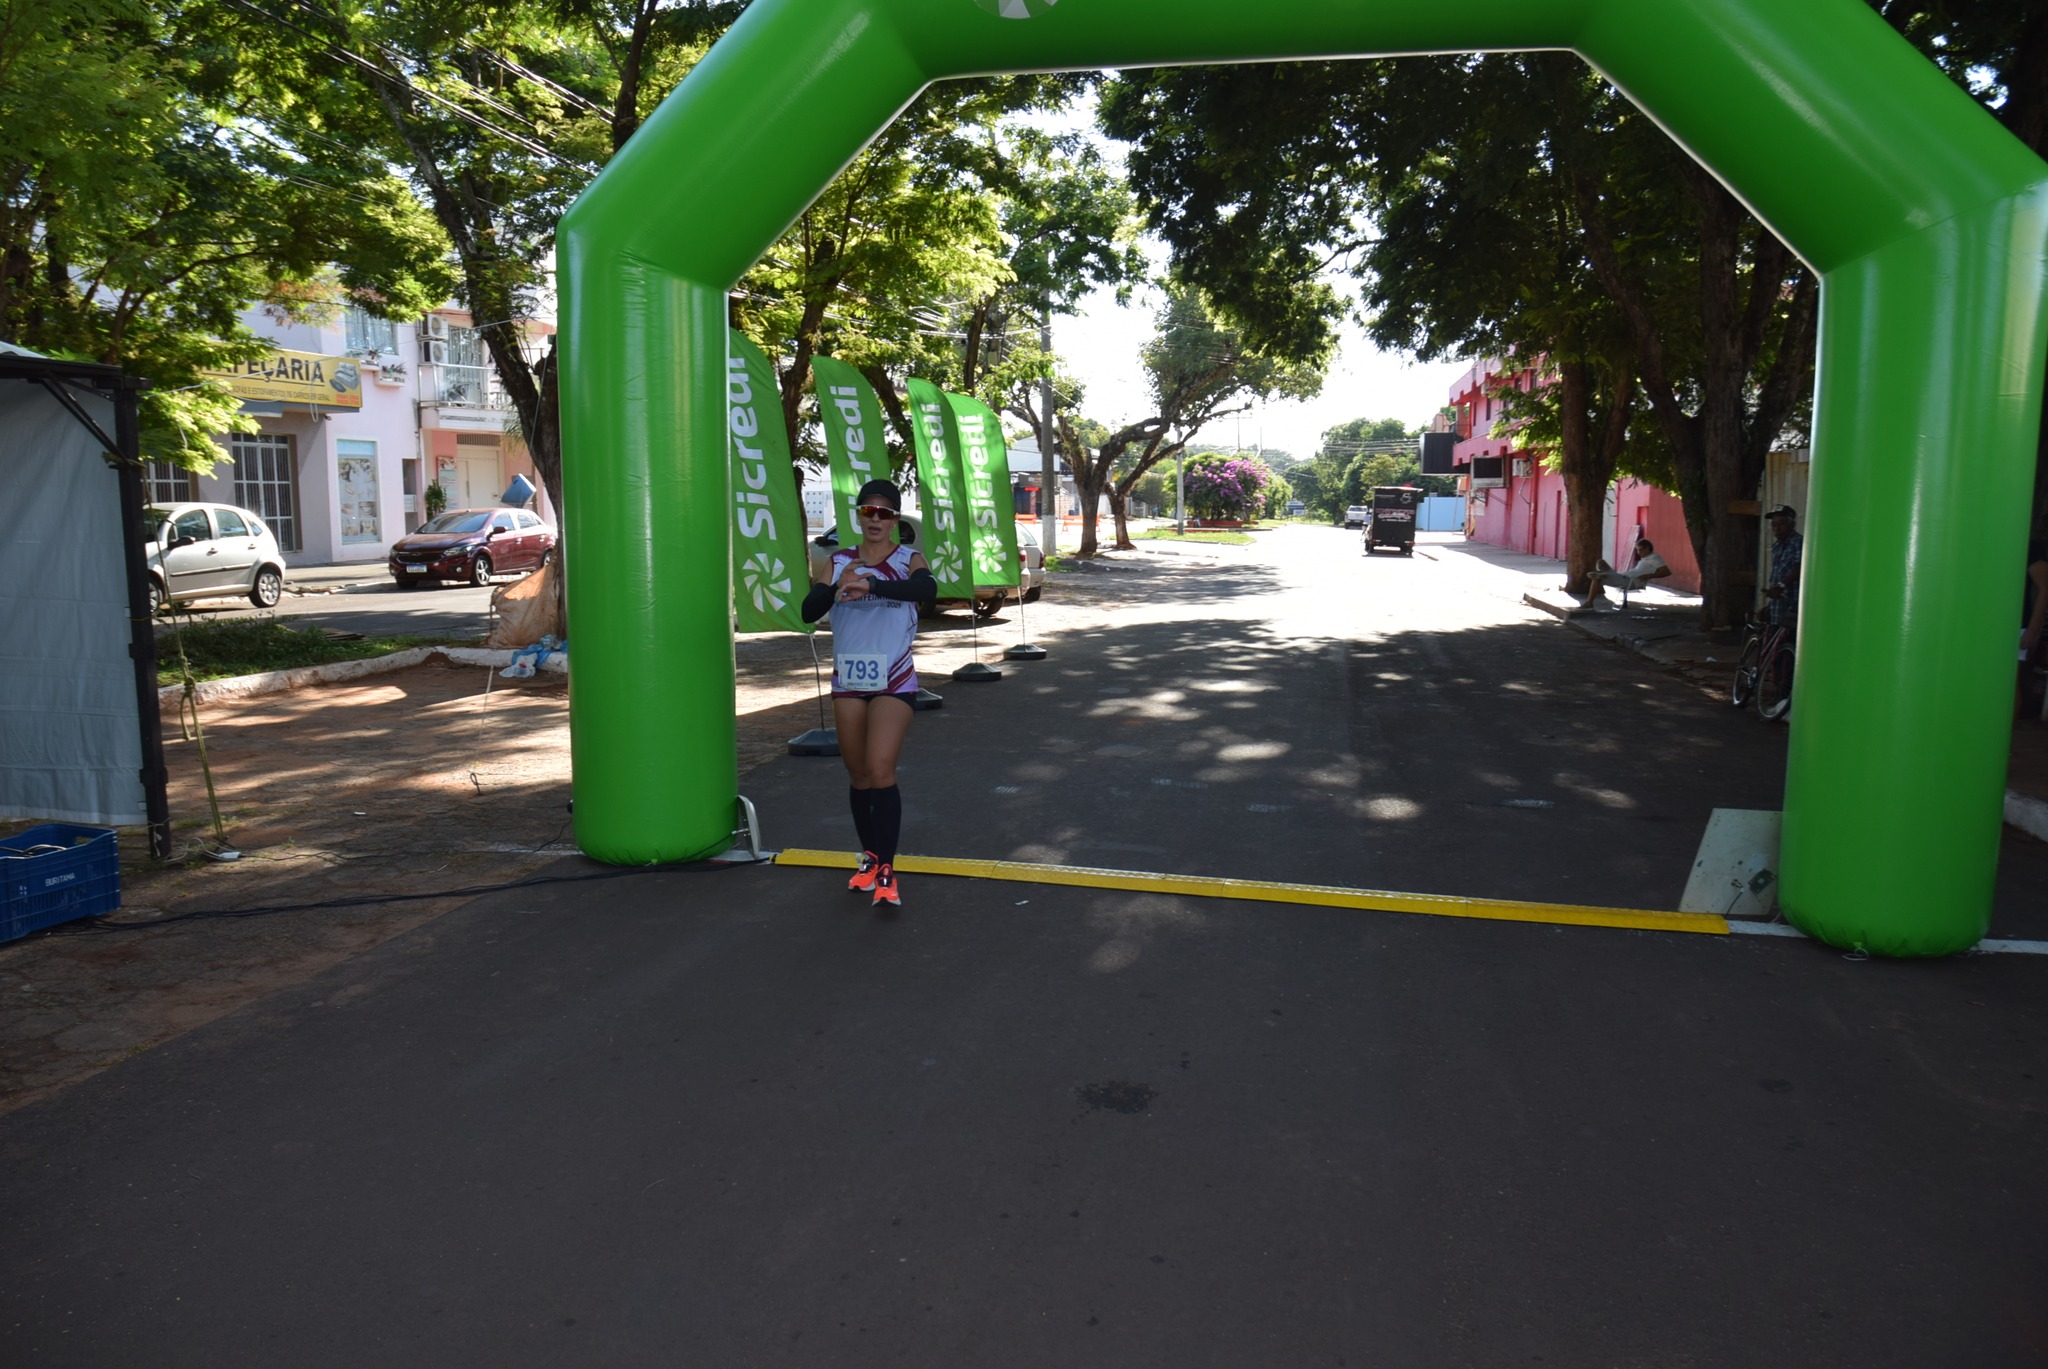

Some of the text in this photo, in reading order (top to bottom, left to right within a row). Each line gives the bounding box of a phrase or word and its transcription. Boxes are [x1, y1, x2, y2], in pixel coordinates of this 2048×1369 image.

[205, 356, 325, 382] PEÇARIA
[829, 385, 872, 534] redi
[920, 403, 956, 533] Sicredi
[958, 413, 998, 529] Sicredi
[844, 660, 879, 680] 793
[45, 873, 75, 886] BURITAMA
